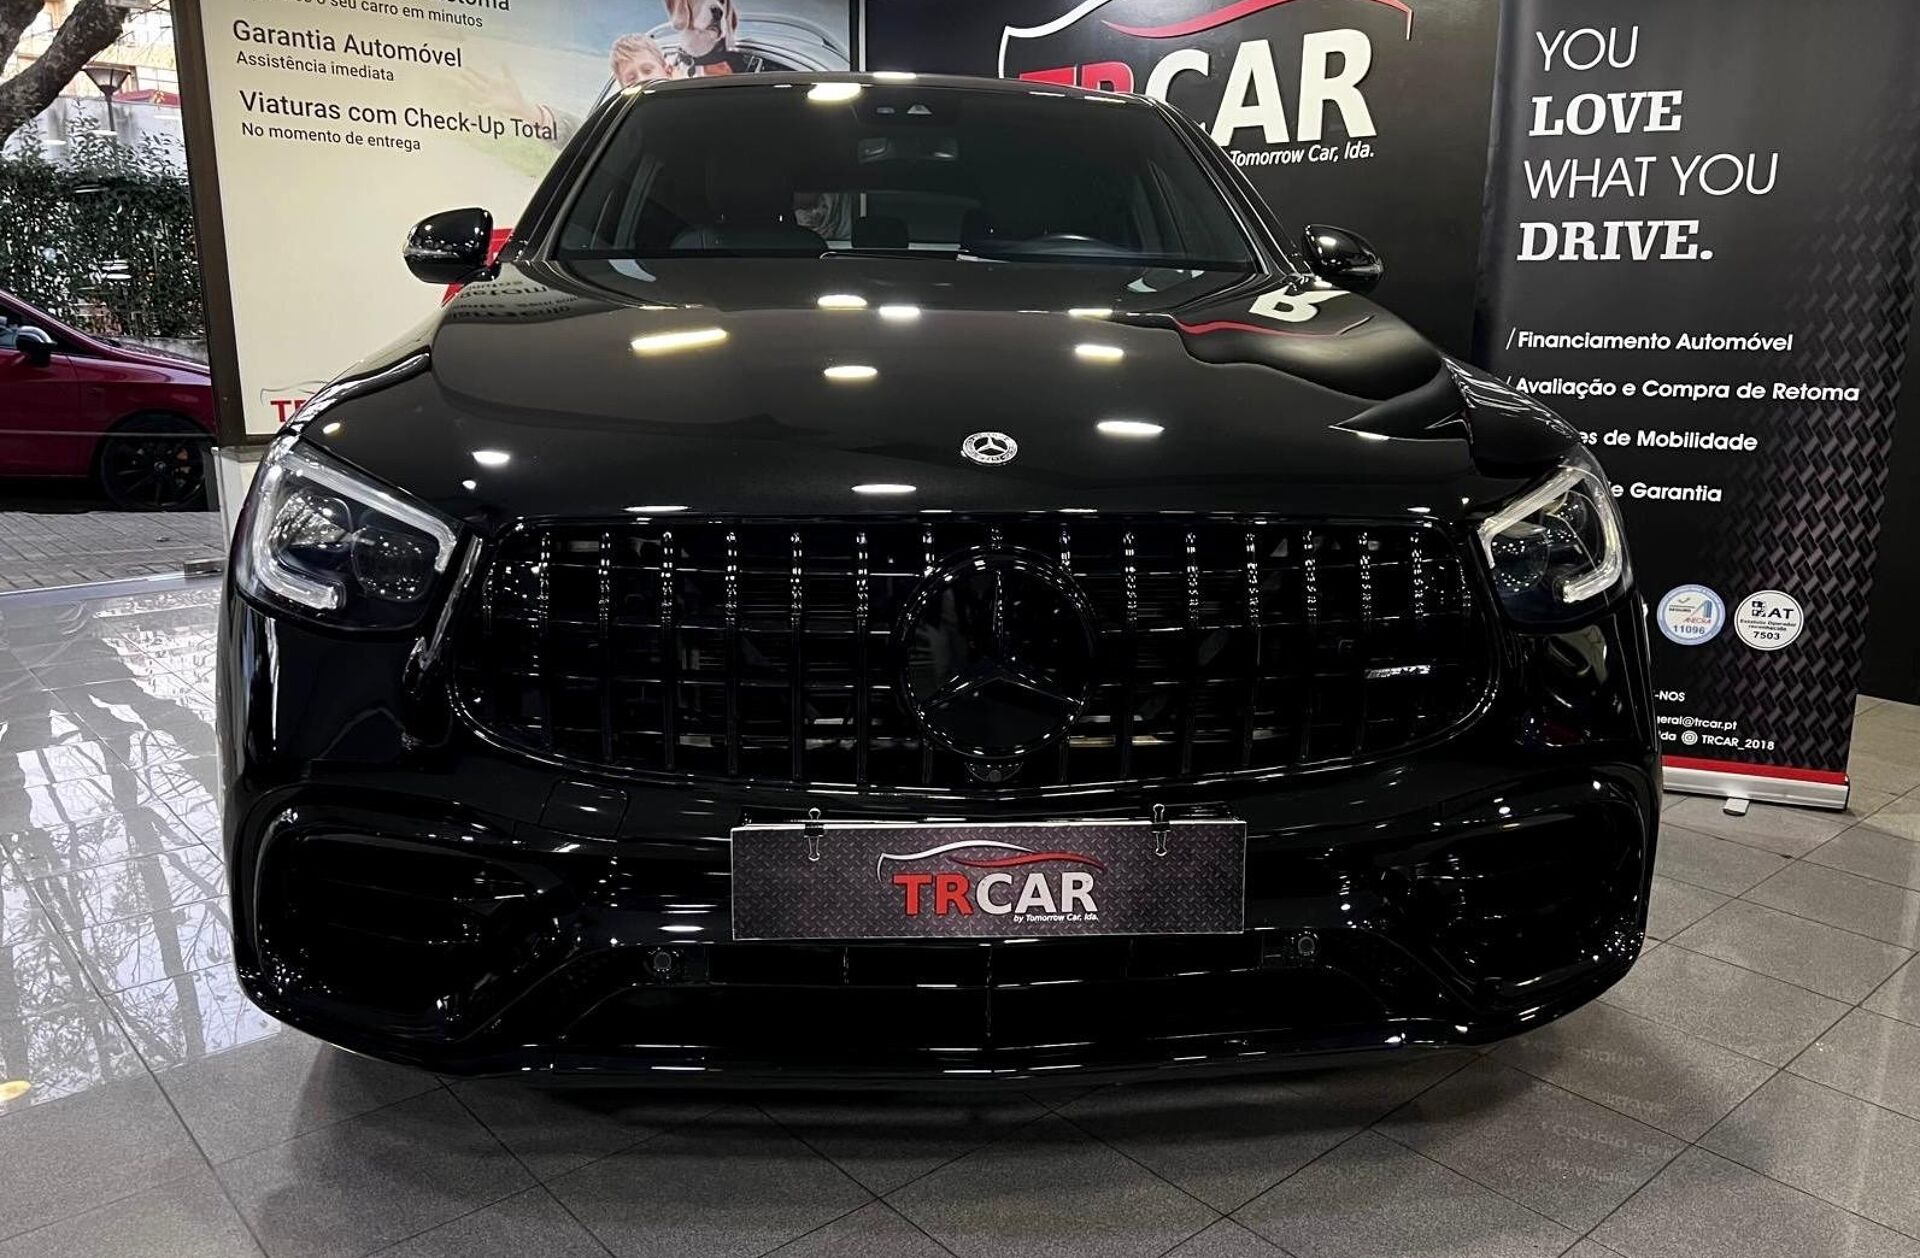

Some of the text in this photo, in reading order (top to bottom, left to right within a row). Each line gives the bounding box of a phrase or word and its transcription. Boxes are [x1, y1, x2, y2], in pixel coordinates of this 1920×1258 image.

[361, 1, 398, 16] carro
[402, 7, 424, 19] em
[428, 10, 483, 28] minutos
[233, 20, 462, 67] Garantia Automóvel
[1536, 25, 1639, 71] YOU
[236, 51, 395, 81] Assistência imediata
[240, 90, 558, 141] Viaturas com Check-Up Total
[1528, 90, 1683, 136] LOVE
[242, 122, 421, 152] No momento de entrega
[1230, 149, 1304, 166] Tomorrow
[1308, 145, 1339, 163] Car,
[1523, 152, 1779, 199] WHAT YOU
[1516, 219, 1714, 261] DRIVE.
[1675, 332, 1793, 351] Automóvel
[1622, 382, 1636, 396] e
[1642, 380, 1730, 401] Compra
[1736, 382, 1766, 399] de
[1772, 382, 1860, 401] Retoma
[1580, 429, 1758, 451] es de Mobilidade
[1609, 481, 1722, 502] e Garantia
[1768, 608, 1794, 619] AT
[1753, 631, 1780, 640] 7503
[1655, 690, 1685, 702] -NOS
[1702, 734, 1775, 751] TRCAR_2018
[892, 871, 1098, 917] TRCAR
[1013, 914, 1024, 924] by
[1026, 914, 1065, 922] Tomorrow
